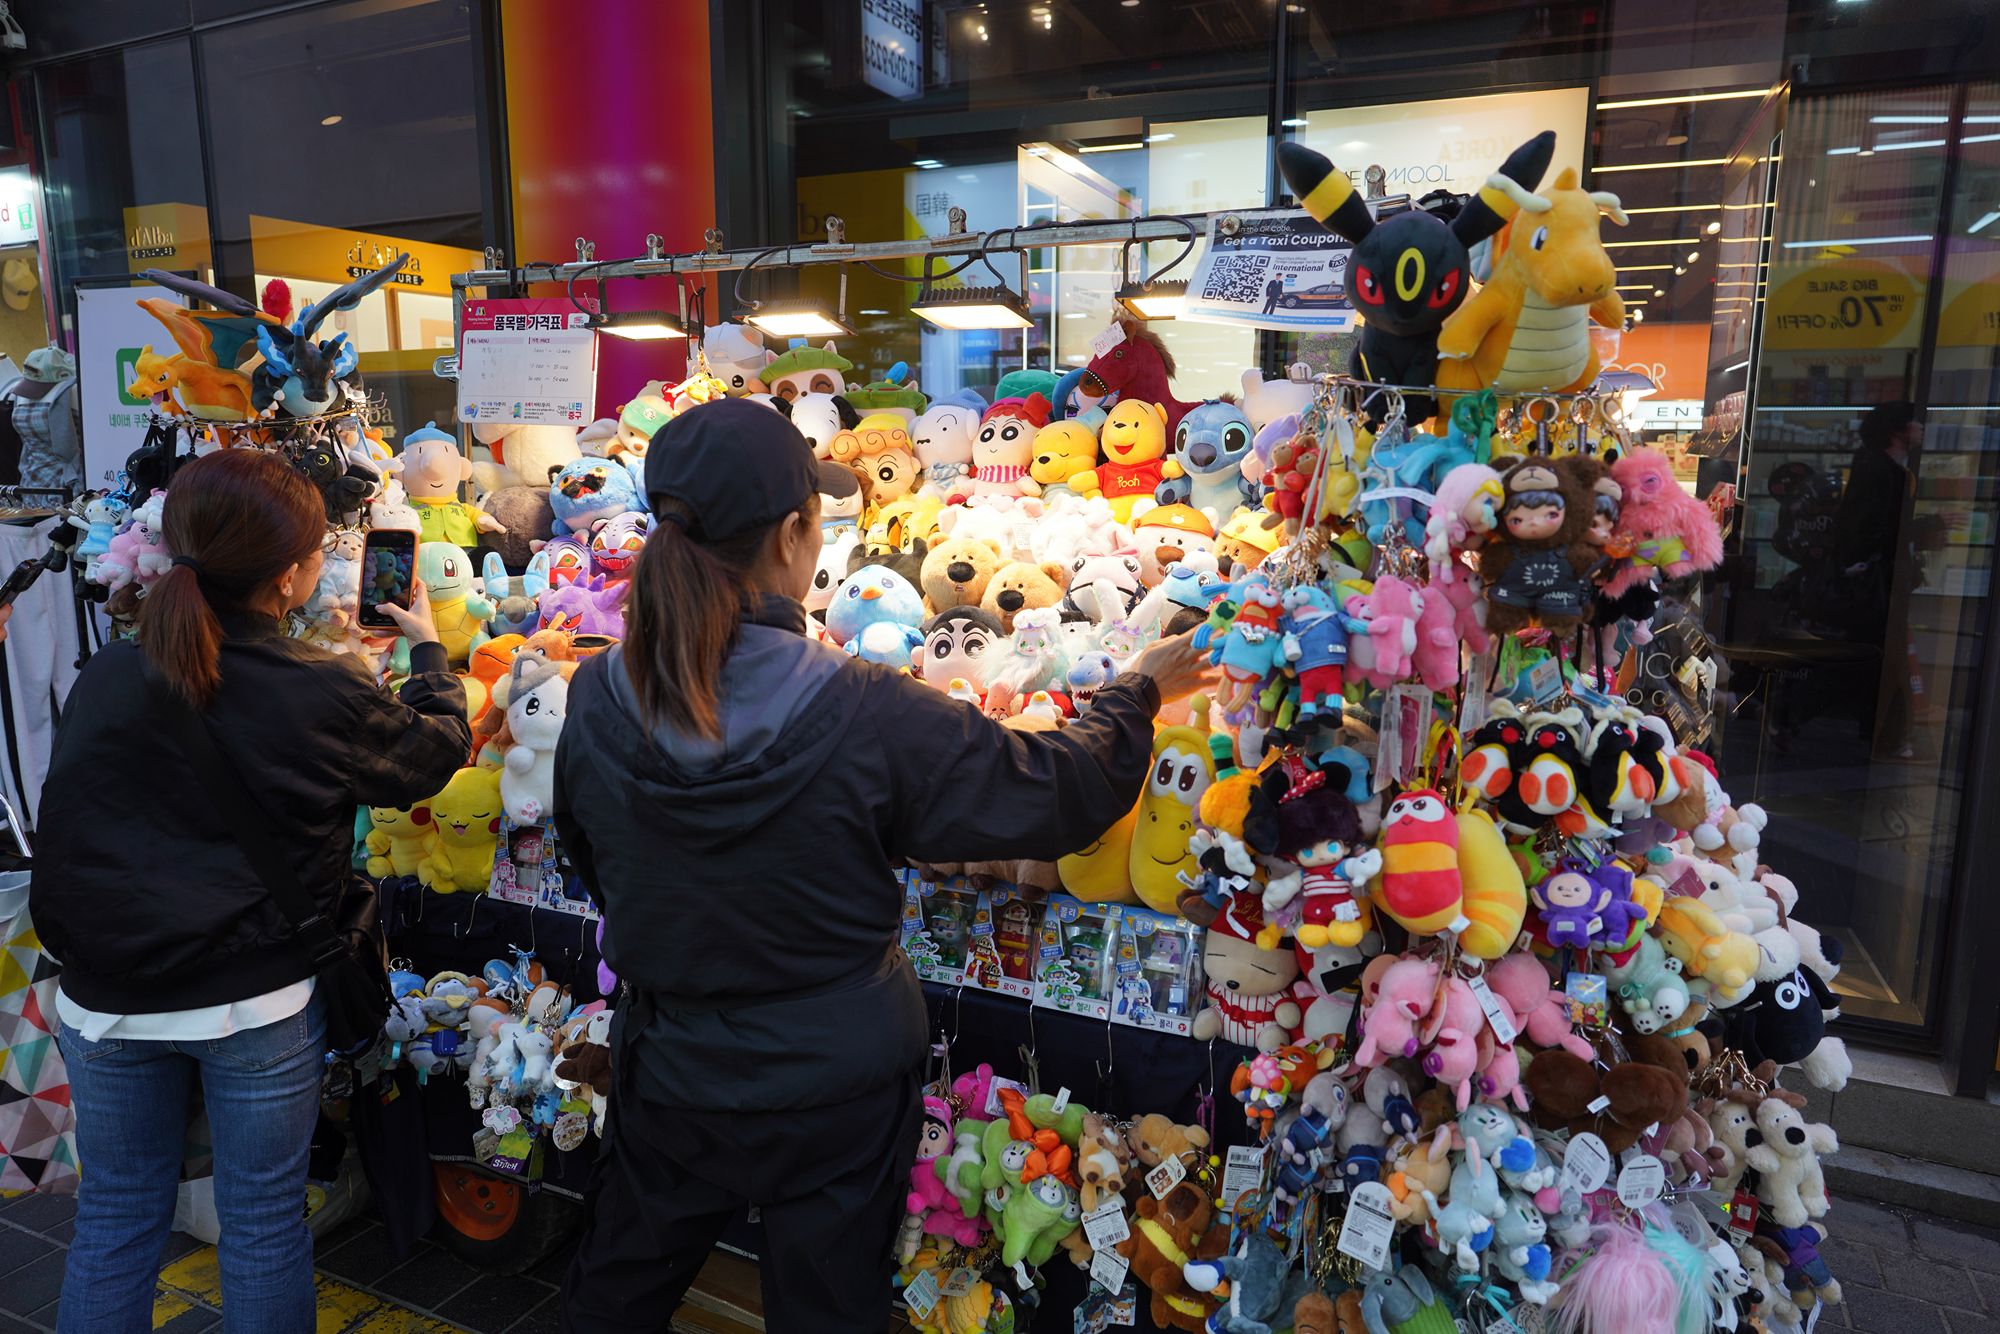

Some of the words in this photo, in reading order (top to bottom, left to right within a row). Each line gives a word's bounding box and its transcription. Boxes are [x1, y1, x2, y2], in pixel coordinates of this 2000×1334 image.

[131, 226, 174, 246] d'Alba
[1223, 236, 1246, 247] Get
[1261, 234, 1288, 246] Taxi
[1273, 263, 1324, 272] International
[1331, 257, 1348, 267] TAXI
[494, 315, 526, 331] 품목별
[528, 315, 562, 330] 가격표
[108, 413, 131, 429] 네이버
[1116, 473, 1140, 488] Pooh
[1060, 905, 1076, 918] 폴리
[1003, 982, 1017, 991] 로이
[1076, 1001, 1091, 1012] 헬리
[1159, 1018, 1173, 1029] 폴리
